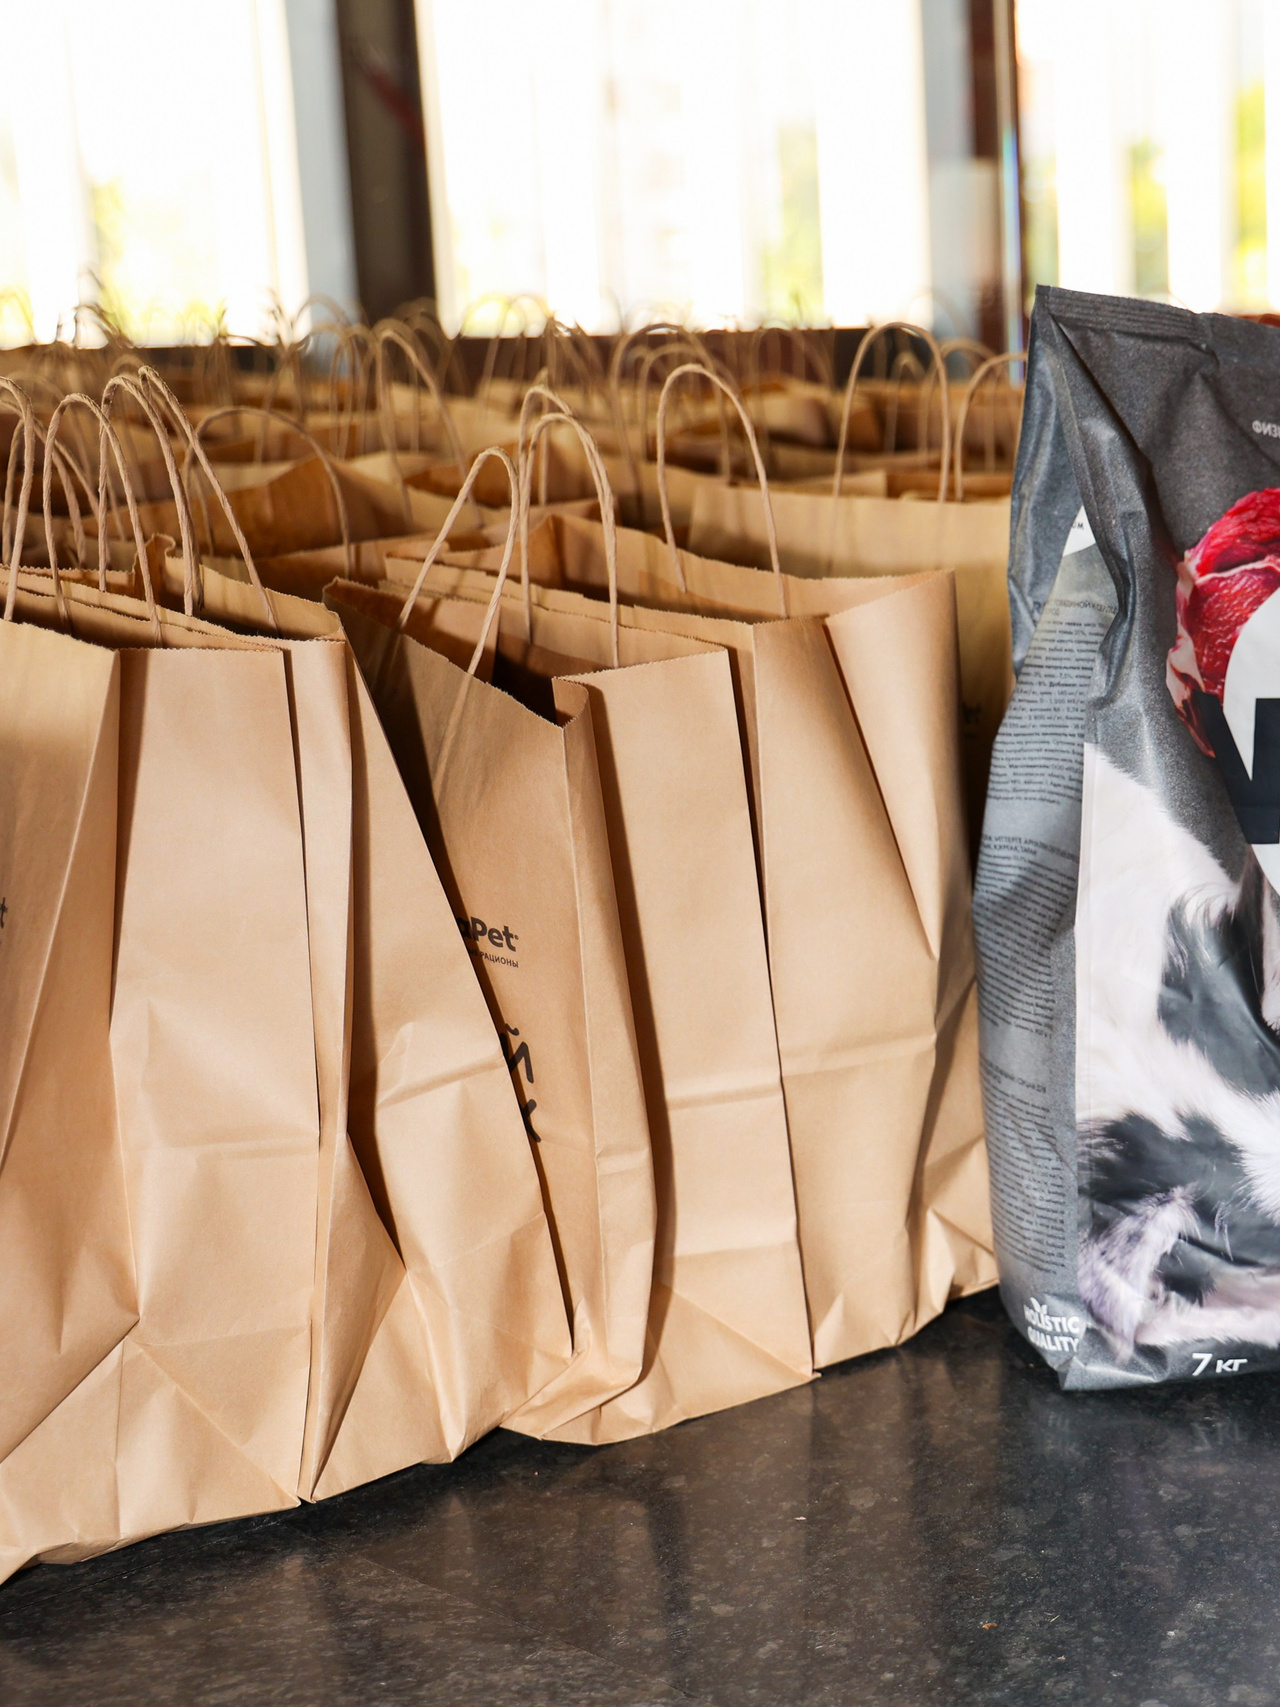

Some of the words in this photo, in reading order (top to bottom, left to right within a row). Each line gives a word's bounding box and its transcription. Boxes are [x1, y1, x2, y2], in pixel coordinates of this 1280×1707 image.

[480, 952, 519, 968] РАЦИОНЫ
[1023, 1304, 1080, 1334] HOLISTIC
[1027, 1326, 1080, 1353] QUALITY
[1191, 1353, 1213, 1376] 7
